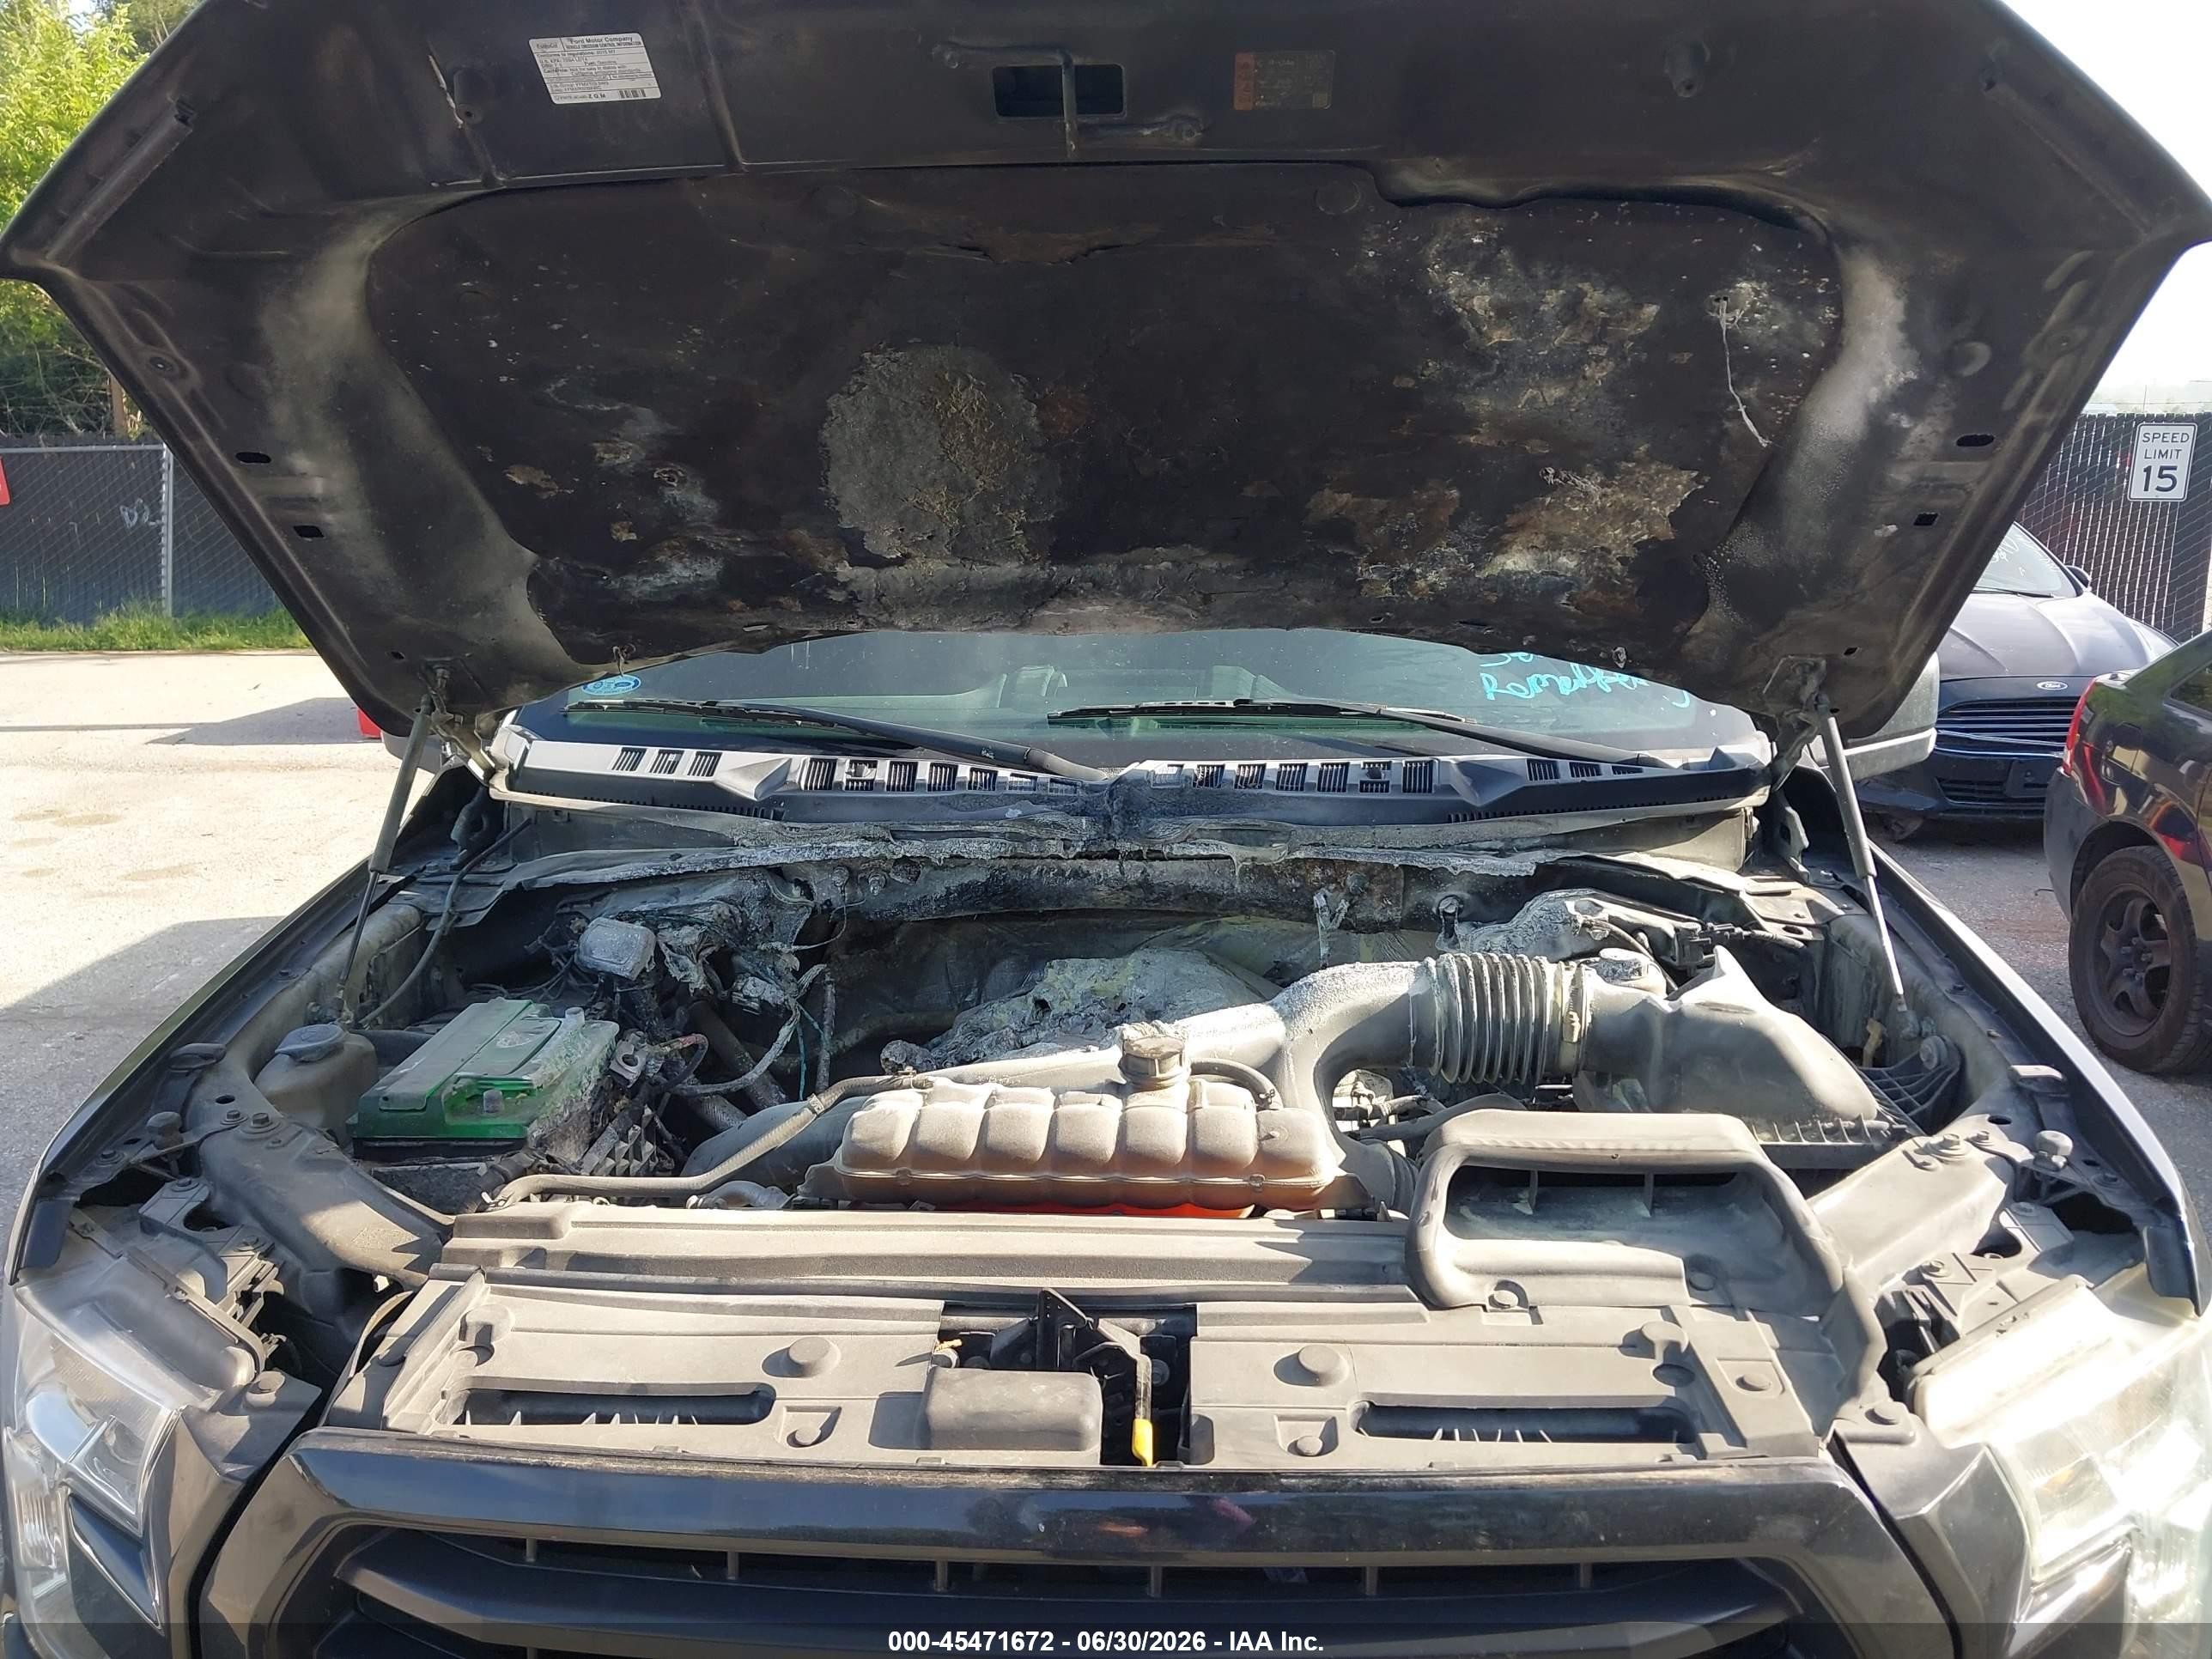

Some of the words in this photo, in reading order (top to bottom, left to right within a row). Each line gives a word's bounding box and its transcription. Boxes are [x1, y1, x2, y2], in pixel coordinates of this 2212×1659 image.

[2142, 433, 2190, 443] SPEED
[2144, 449, 2183, 459] LIMIT
[2143, 465, 2178, 492] 15
